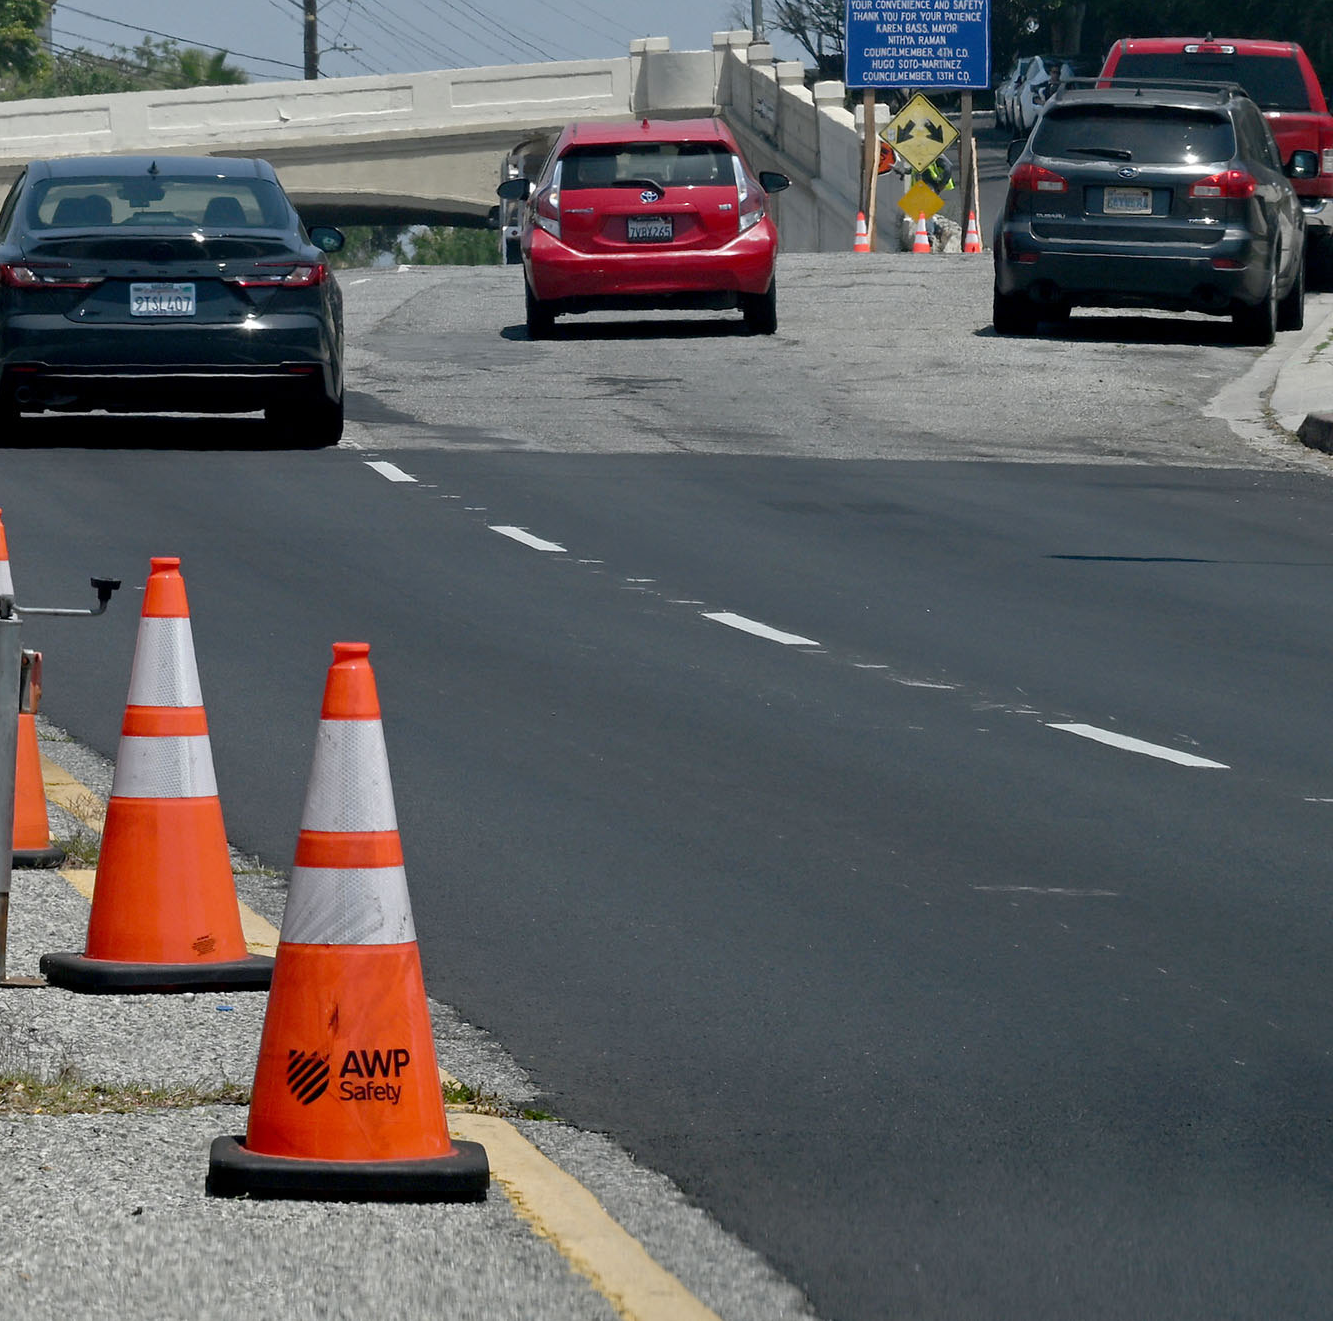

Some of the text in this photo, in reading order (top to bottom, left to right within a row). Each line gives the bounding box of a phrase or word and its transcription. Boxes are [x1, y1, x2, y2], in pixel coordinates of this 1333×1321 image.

[851, 0, 984, 10] YOUR CONVENIENCE AND SAFETY
[853, 11, 982, 22] THANK YOU FOR YOUR PATIENCE
[876, 23, 903, 33] KAREN
[931, 23, 958, 33] MAYOR
[888, 35, 947, 45] NITHYA RAMAN
[937, 47, 953, 57] 4TH
[955, 48, 970, 58] C.D.
[872, 59, 895, 69] HUGO
[937, 71, 955, 81] 13TH
[957, 71, 971, 82] C.D.
[134, 295, 192, 312] 9TSL407
[338, 1048, 411, 1079] AWP
[339, 1080, 402, 1106] Safety
